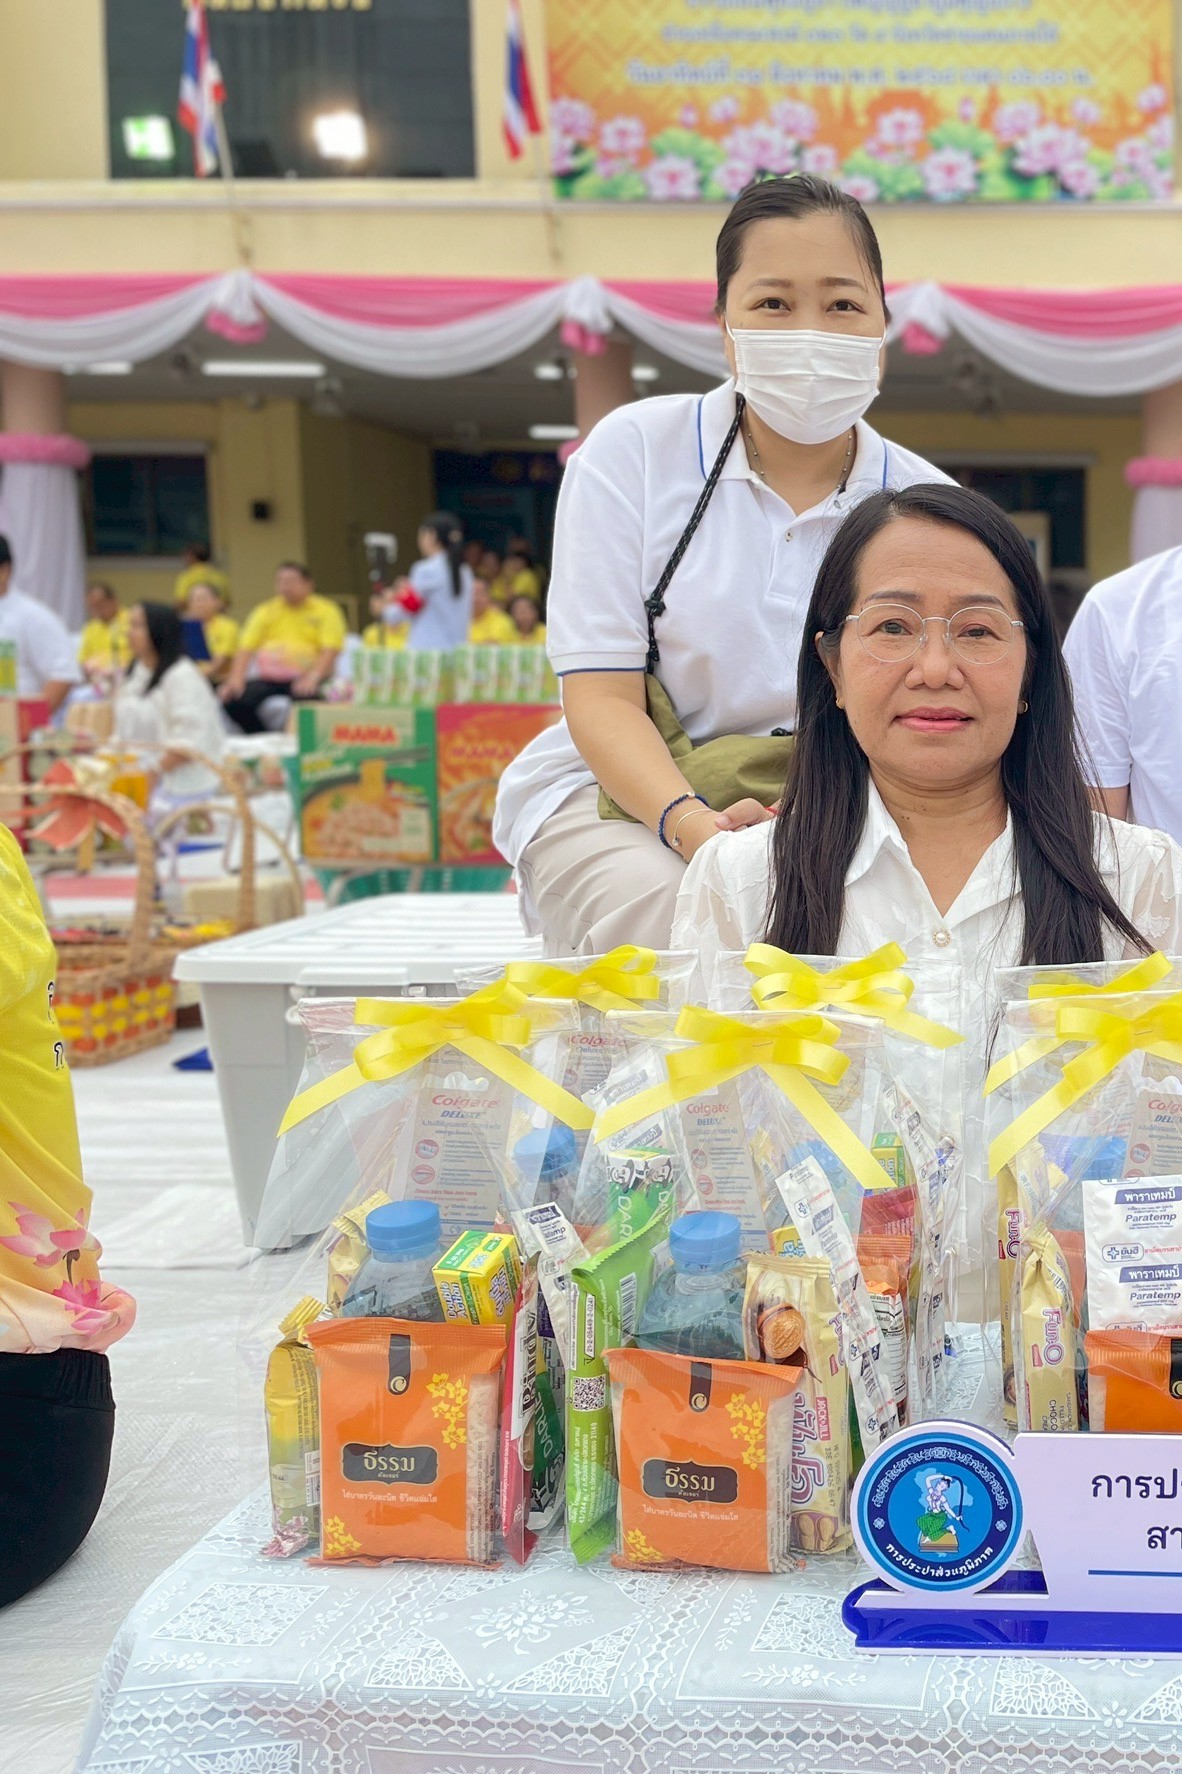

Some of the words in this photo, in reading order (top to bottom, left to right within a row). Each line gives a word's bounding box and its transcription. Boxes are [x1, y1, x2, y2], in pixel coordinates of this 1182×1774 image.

[331, 724, 398, 744] MAMA
[431, 1094, 499, 1109] Colgate
[686, 1102, 730, 1117] Colgate
[1124, 1187, 1177, 1202] พาราเทมป์
[1125, 1212, 1177, 1222] Paratemp
[1120, 1246, 1139, 1255] ยันฮี
[1128, 1265, 1180, 1280] พาราเทมป์
[440, 1281, 459, 1319] Double
[450, 1282, 468, 1319] Action
[1129, 1290, 1181, 1300] Paratemp
[535, 1390, 554, 1459] DARLIE
[1049, 1399, 1058, 1430] CHOCO
[363, 1449, 415, 1472] ธรรม
[665, 1466, 715, 1491] ธรรม
[885, 1542, 994, 1578] การประปาส่วนภูมิภาค
